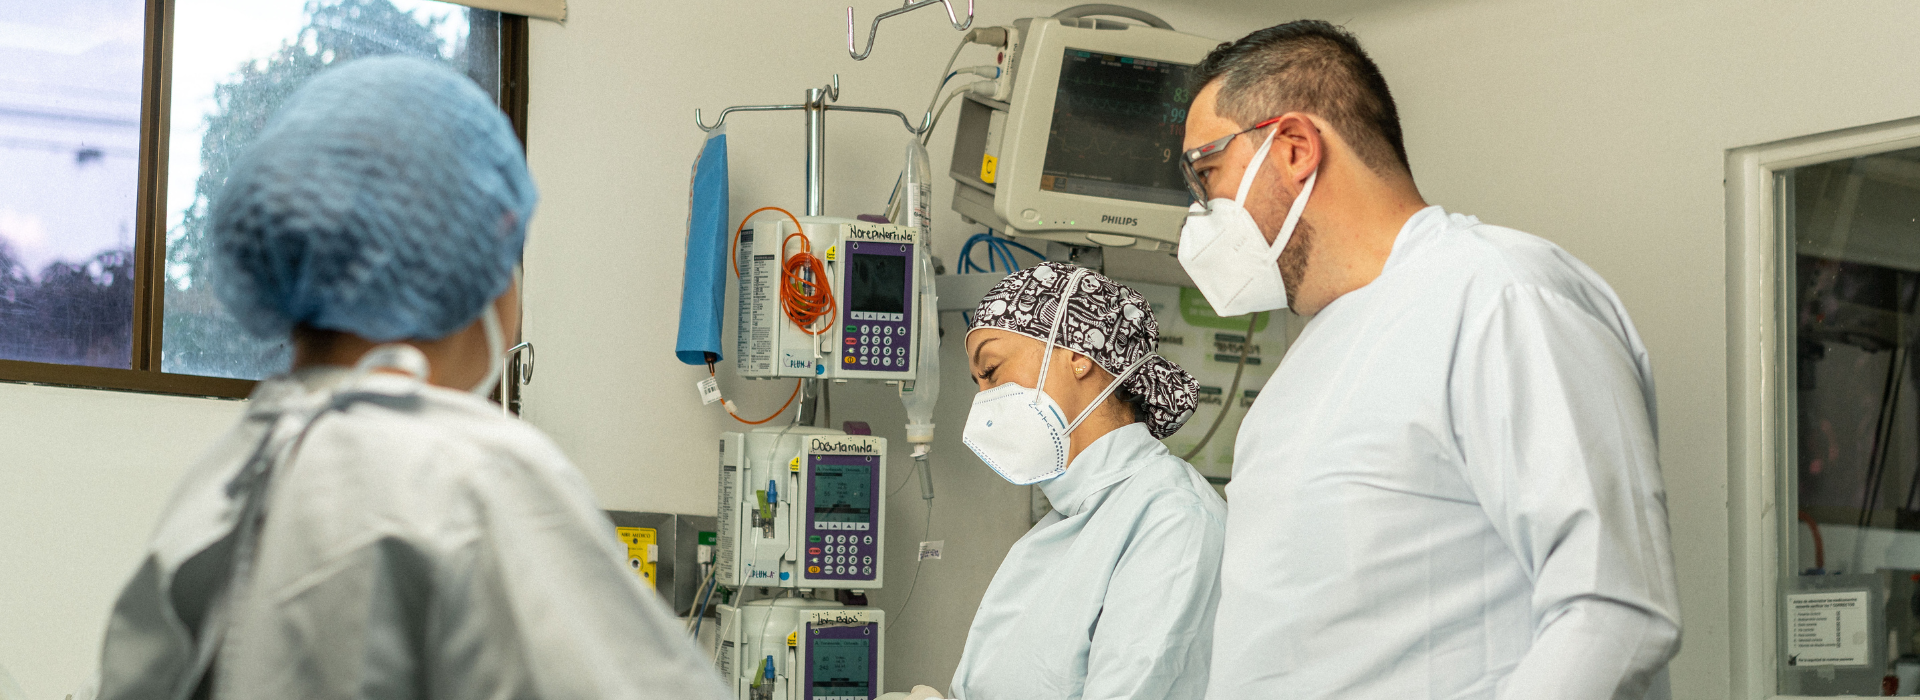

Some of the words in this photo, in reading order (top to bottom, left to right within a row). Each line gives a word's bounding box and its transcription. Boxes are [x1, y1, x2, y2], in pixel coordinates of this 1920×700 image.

[1174, 88, 1189, 103] 83
[1171, 108, 1186, 123] 99
[1102, 215, 1137, 227] PHILIPS
